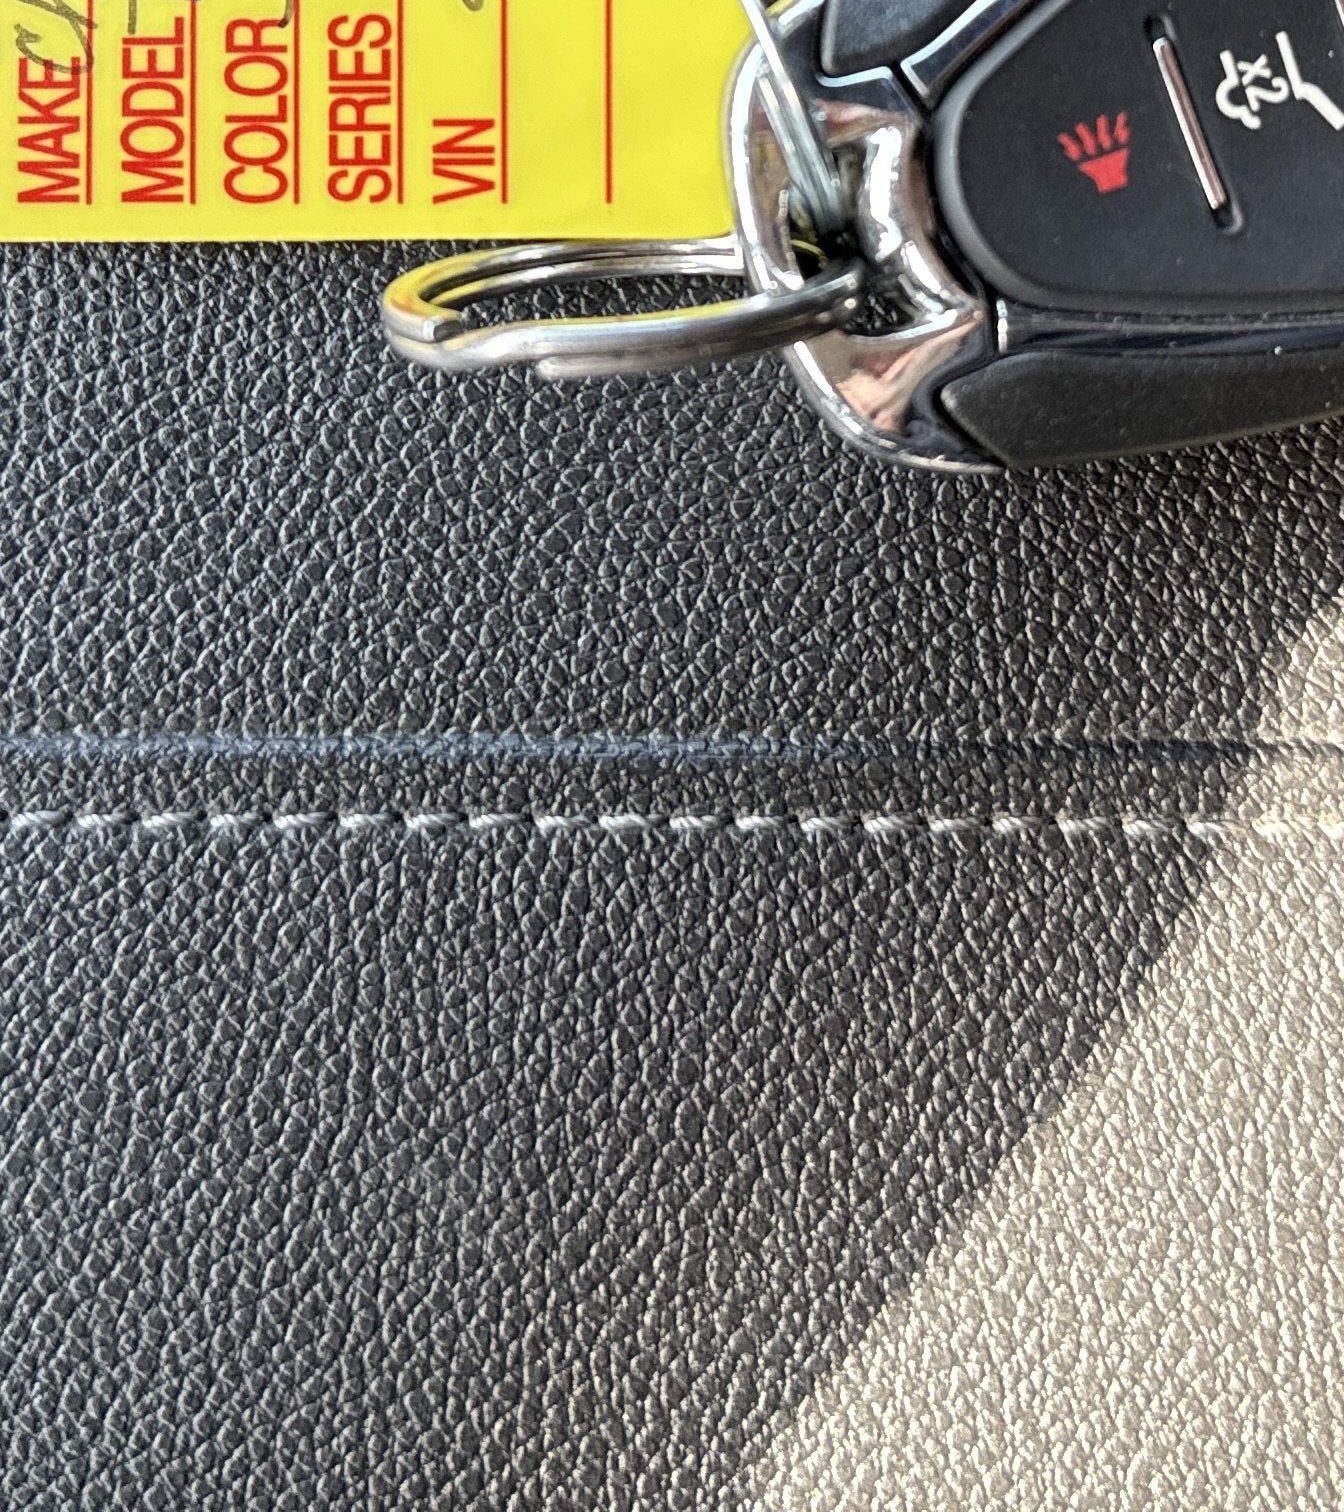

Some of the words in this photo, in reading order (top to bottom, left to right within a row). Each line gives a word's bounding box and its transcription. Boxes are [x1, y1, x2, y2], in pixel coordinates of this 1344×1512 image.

[17, 55, 80, 203] MAKE
[120, 17, 184, 203] MODEL
[224, 18, 288, 203] COLOR
[328, 13, 392, 203] SERIES
[433, 118, 495, 203] VIN
